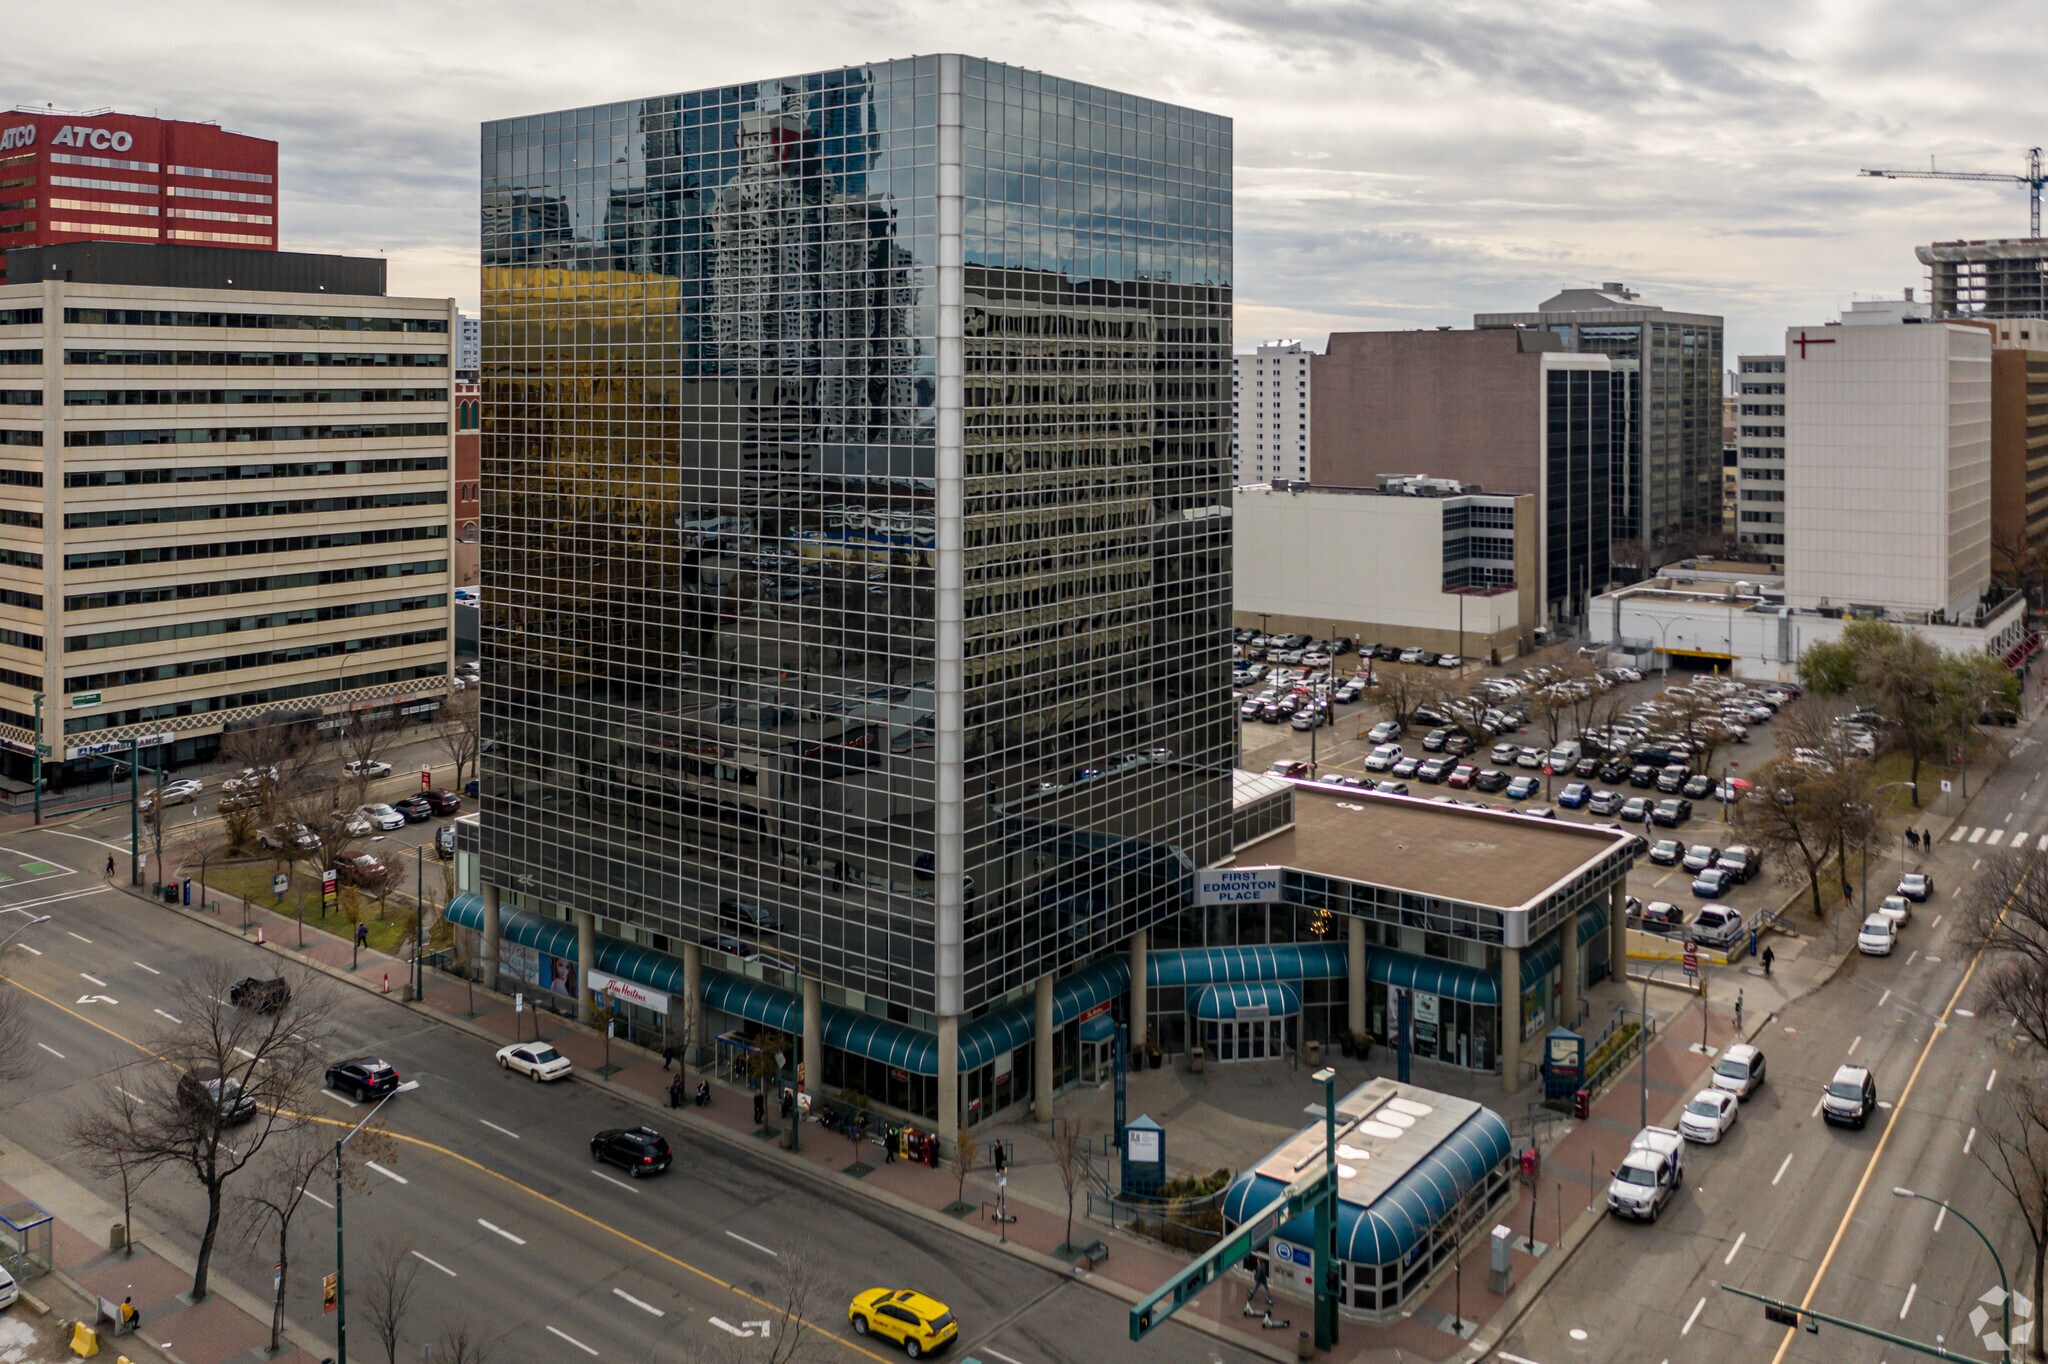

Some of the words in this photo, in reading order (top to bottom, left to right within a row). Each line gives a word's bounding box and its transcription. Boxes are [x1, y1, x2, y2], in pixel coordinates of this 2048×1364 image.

[0, 124, 37, 150] ATCO
[51, 125, 133, 152] ATCO
[110, 736, 164, 751] INSUANCE
[1222, 872, 1258, 881] FIRST
[1203, 881, 1276, 892] EDMONTON
[1220, 891, 1261, 901] PLACE
[608, 979, 621, 993] Tim
[621, 983, 646, 1002] Hortons
